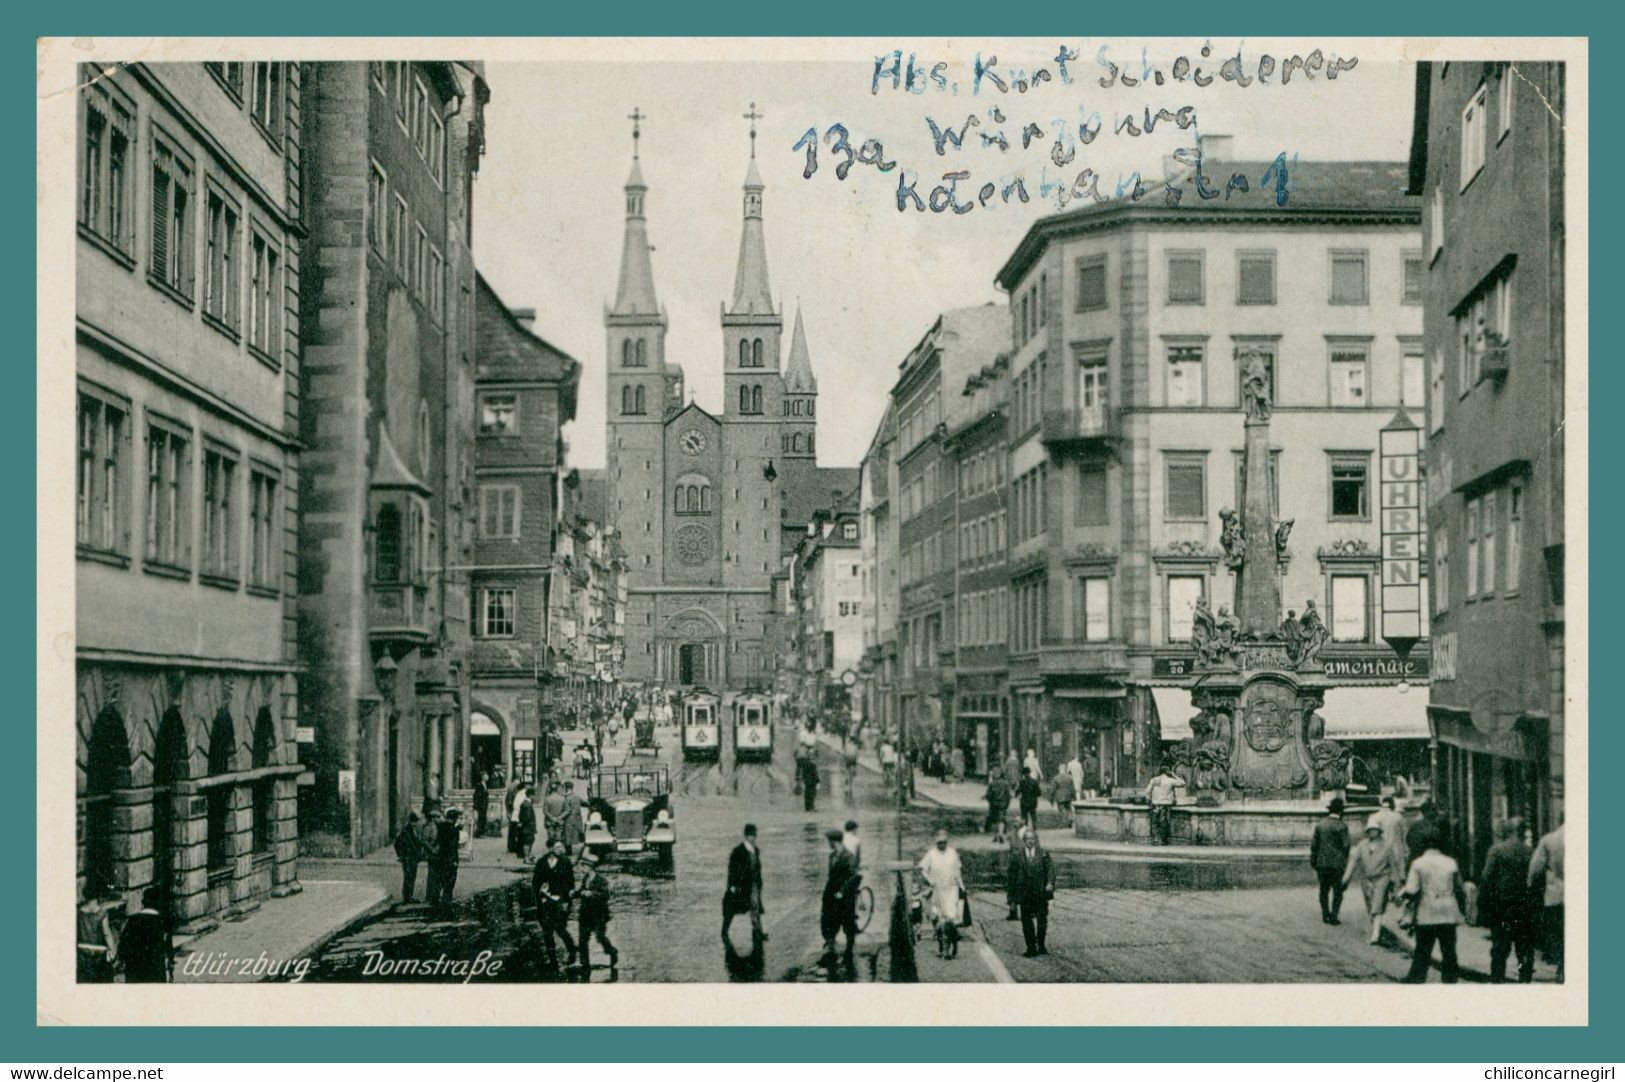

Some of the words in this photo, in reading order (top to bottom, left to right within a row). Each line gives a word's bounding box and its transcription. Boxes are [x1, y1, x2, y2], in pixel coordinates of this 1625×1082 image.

[871, 50, 959, 96] Abs.
[973, 44, 1082, 97] Kurt
[1097, 38, 1359, 88] Scheiderer
[791, 122, 898, 181] 13a
[925, 103, 1201, 168] Würzburg
[1389, 458, 1412, 583] UHREN
[1324, 658, 1418, 676] amenhüte
